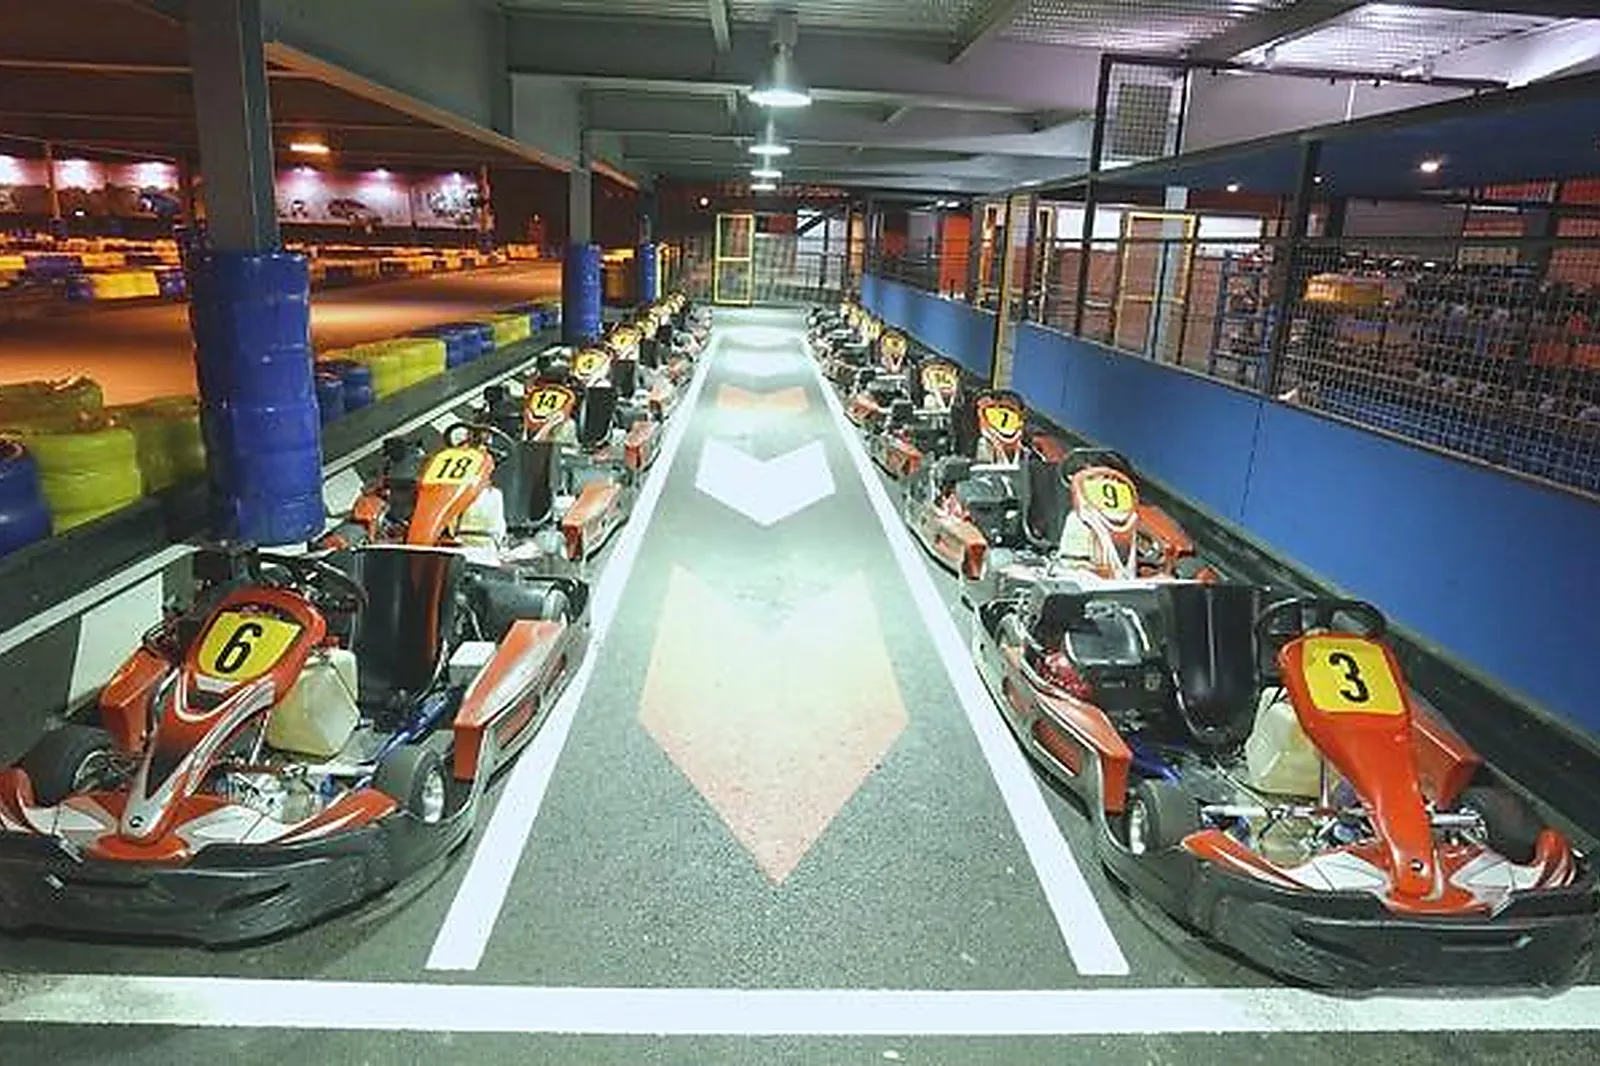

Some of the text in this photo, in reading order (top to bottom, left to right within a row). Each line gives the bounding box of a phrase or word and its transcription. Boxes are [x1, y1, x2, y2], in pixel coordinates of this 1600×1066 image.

[537, 392, 558, 409] 14
[436, 455, 472, 480] 18
[1102, 483, 1119, 508] 9
[214, 621, 263, 674] 6
[1328, 652, 1369, 703] 3
